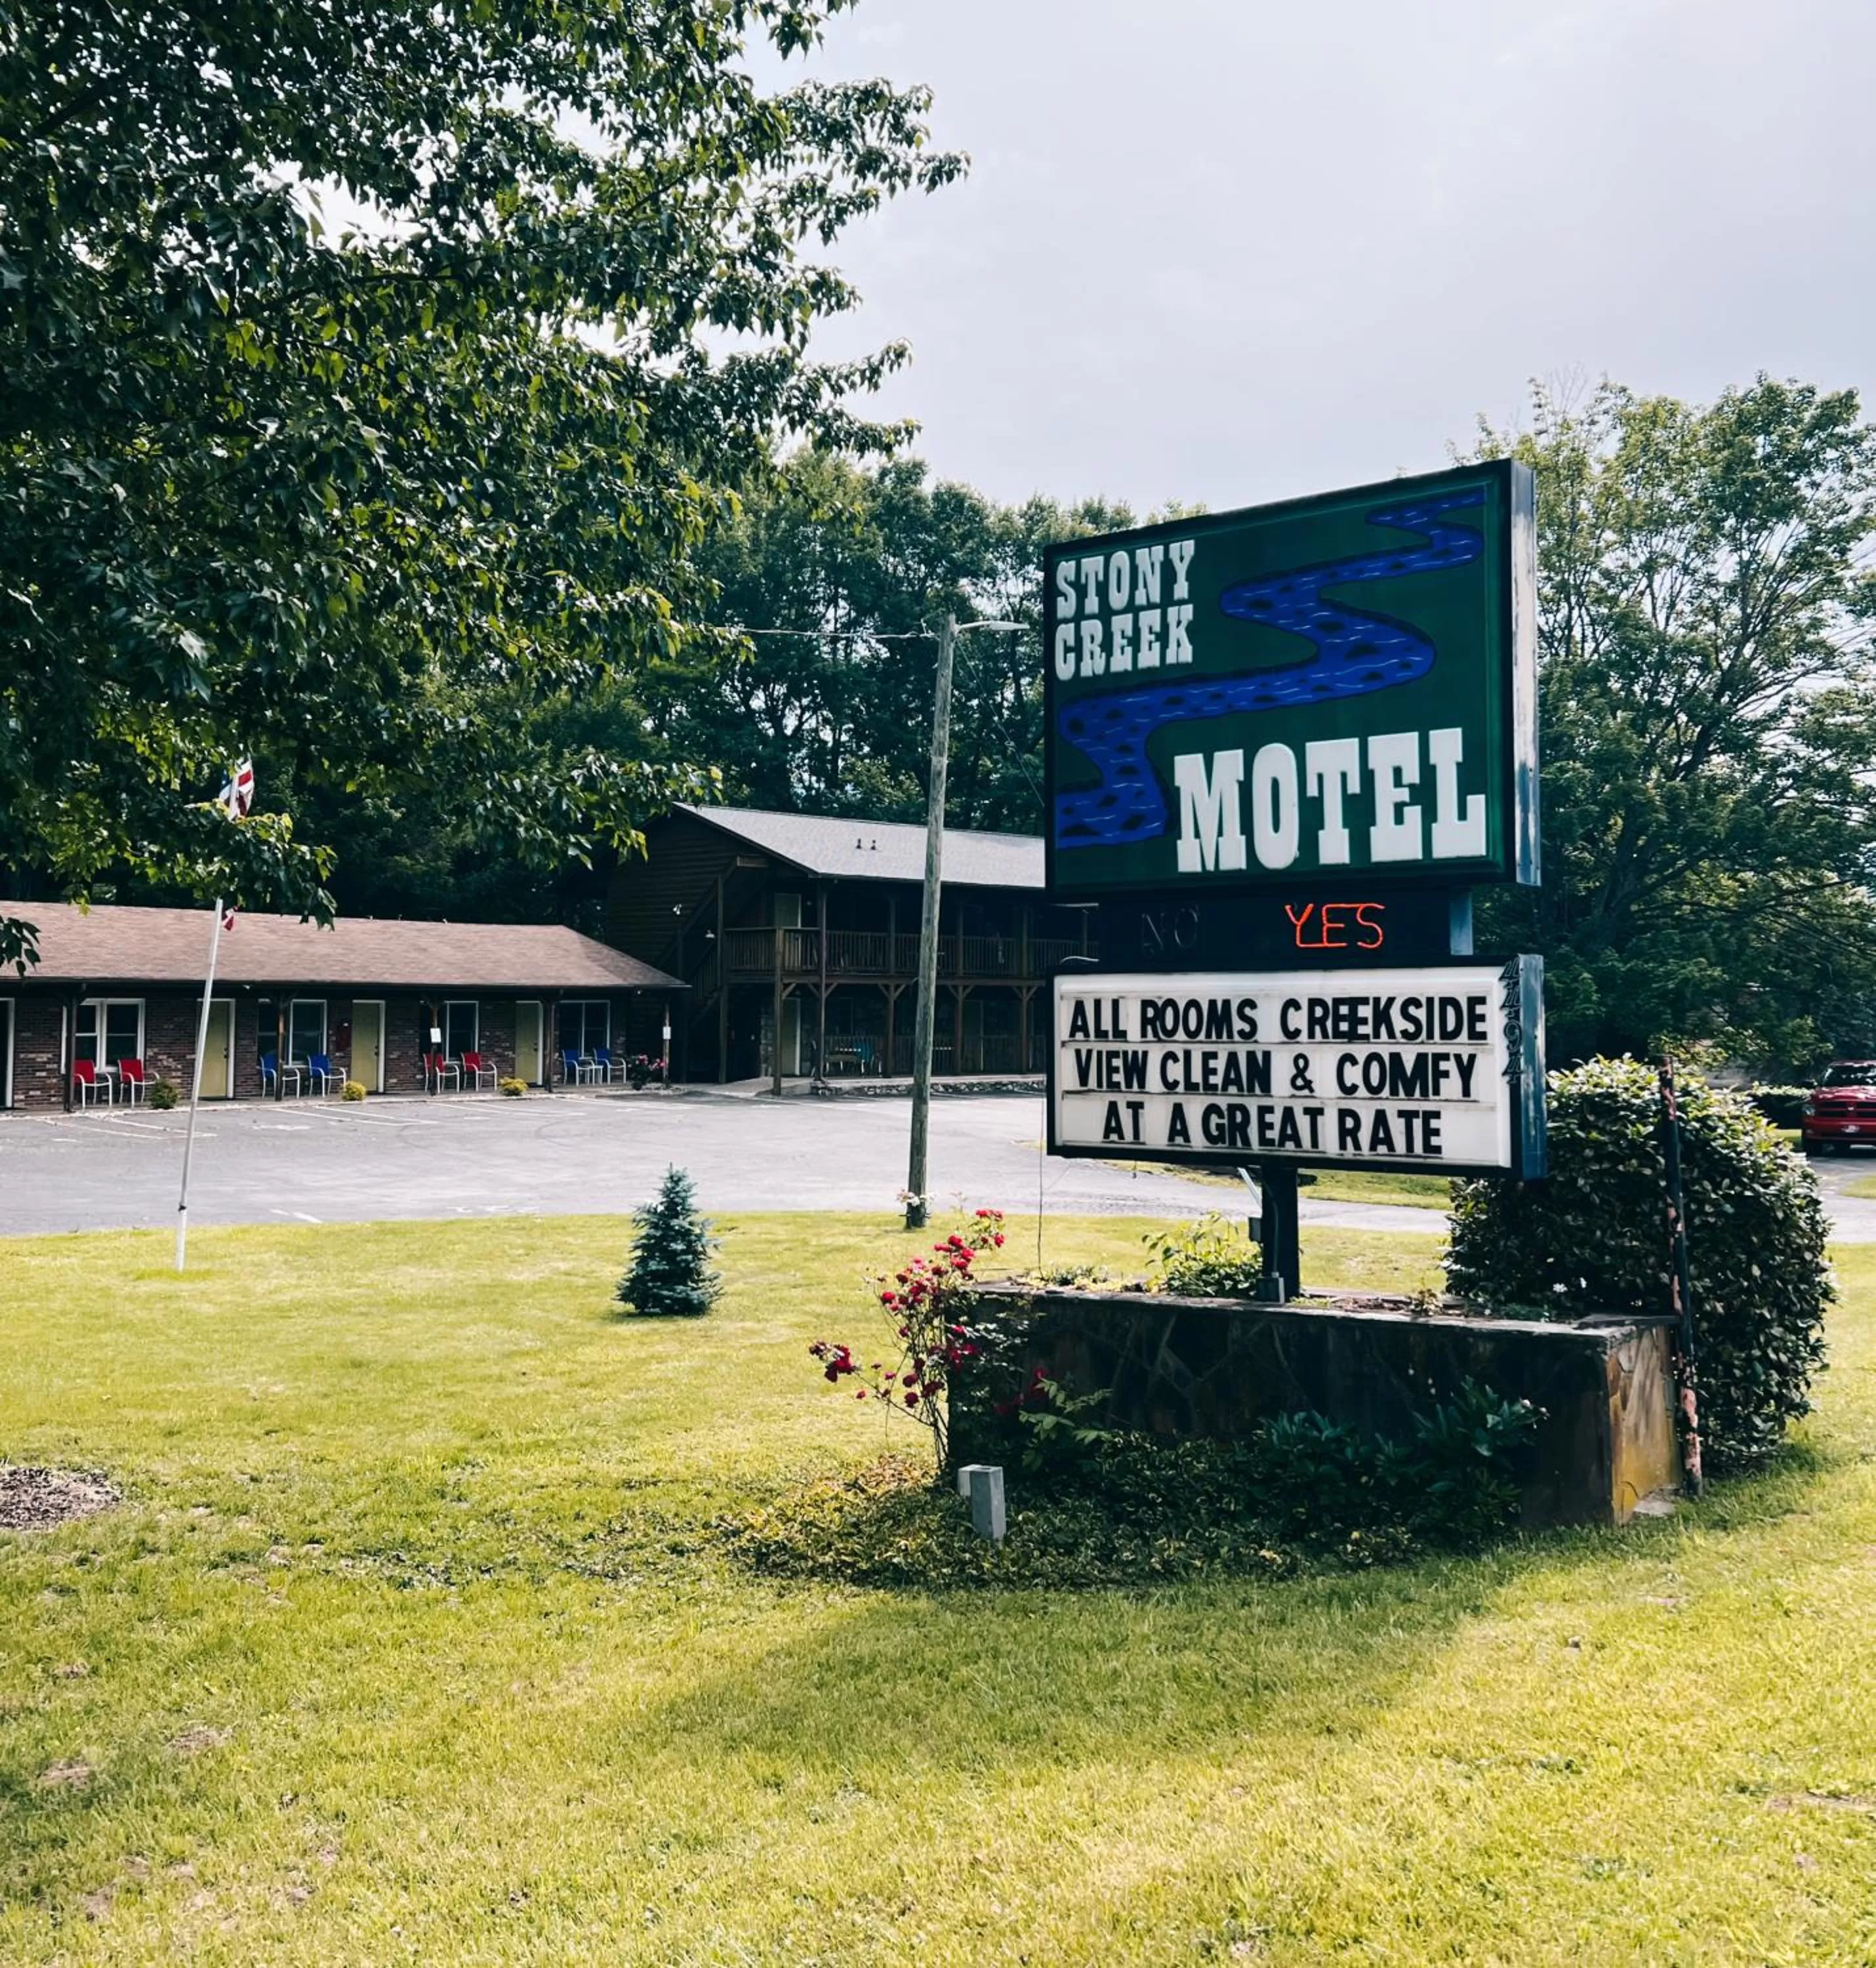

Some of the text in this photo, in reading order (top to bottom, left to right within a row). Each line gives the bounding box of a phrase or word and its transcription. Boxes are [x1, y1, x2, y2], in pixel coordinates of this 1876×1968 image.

[1056, 540, 1195, 620] STONY
[1055, 604, 1194, 681] CREEK
[1173, 727, 1486, 873] MOTEL
[1141, 902, 1385, 951] NO YES
[1069, 995, 1488, 1042] ALL ROOMS CREEKSIDE
[1074, 1048, 1477, 1099] VIEW CLEAN & COMFY
[1103, 1100, 1442, 1154] AT A GREAT RATE
